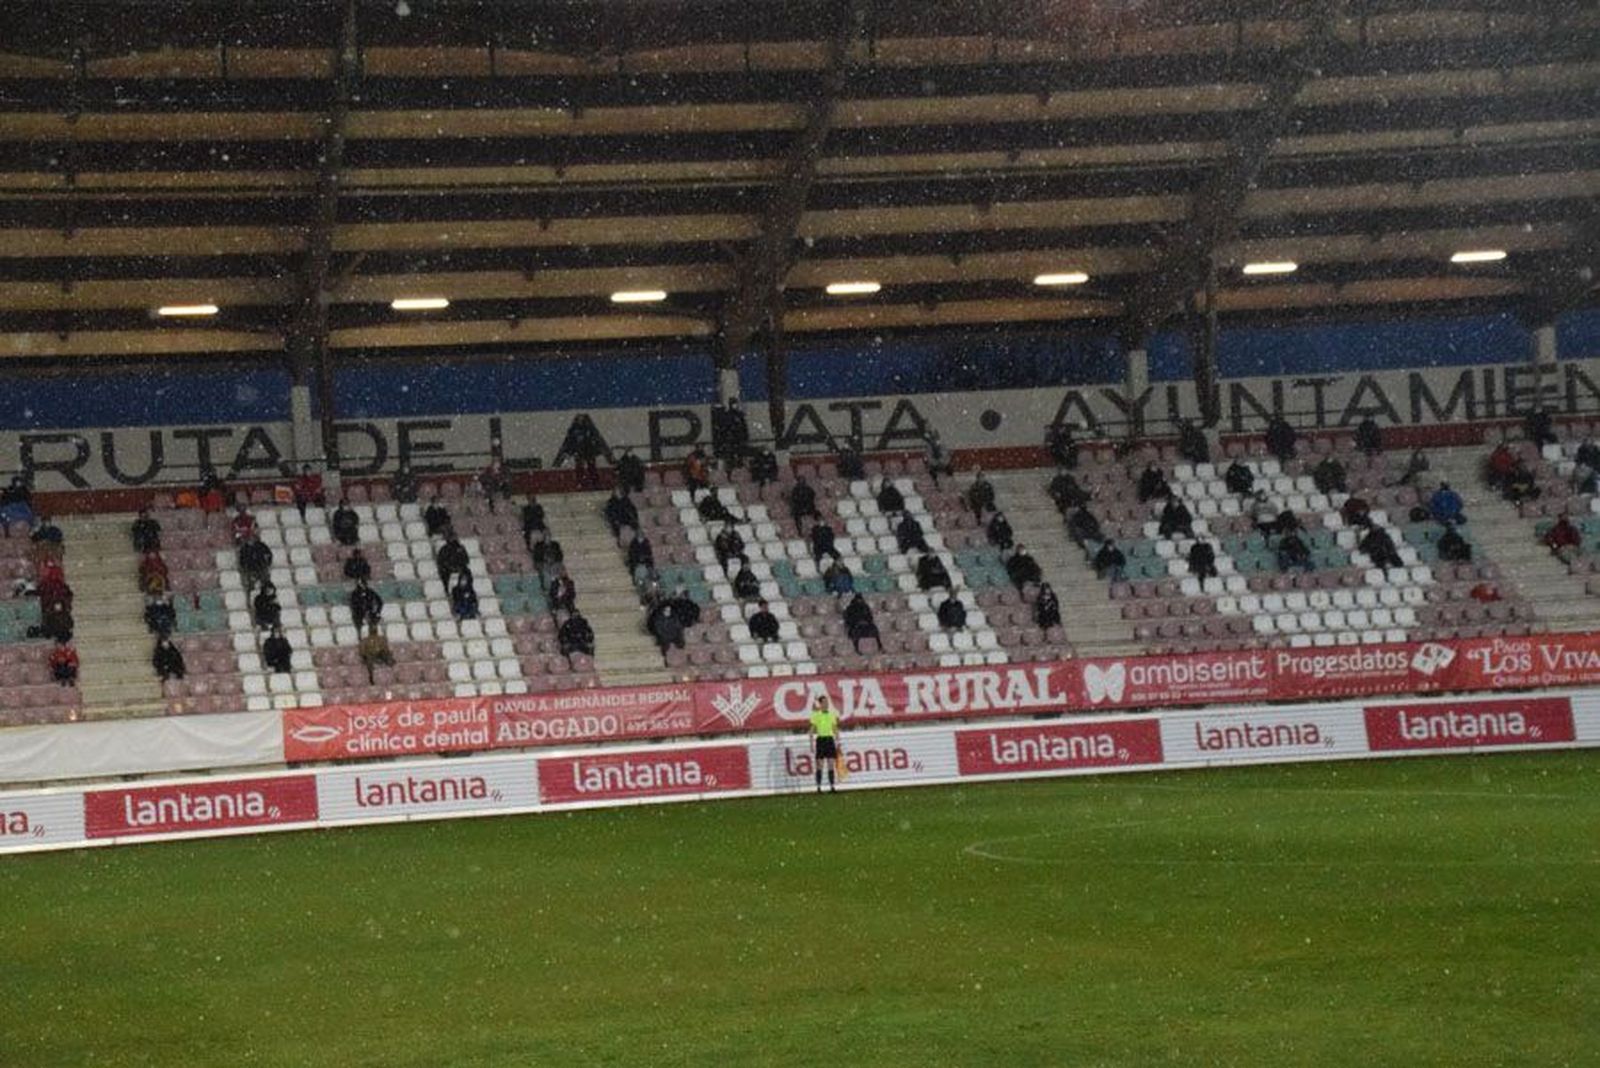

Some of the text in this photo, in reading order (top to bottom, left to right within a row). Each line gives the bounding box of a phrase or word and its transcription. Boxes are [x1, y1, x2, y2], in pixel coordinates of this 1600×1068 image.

[19, 427, 302, 489] RUTA
[322, 419, 453, 476] DE
[1131, 655, 1267, 685] ambiseint
[1277, 648, 1409, 678] Progesdatos
[494, 701, 535, 714] DAVID
[773, 667, 1067, 720] CAJA RURAL
[348, 701, 488, 734] josé de paula
[497, 714, 618, 742] ABOGADO
[1399, 709, 1526, 740] lantania
[346, 727, 489, 753] clínica dental
[991, 731, 1116, 762] lantania
[1195, 719, 1320, 751] lantania
[573, 758, 702, 794] lantania
[784, 747, 909, 777] laania
[355, 773, 488, 808] lantania
[125, 790, 266, 827] lantania
